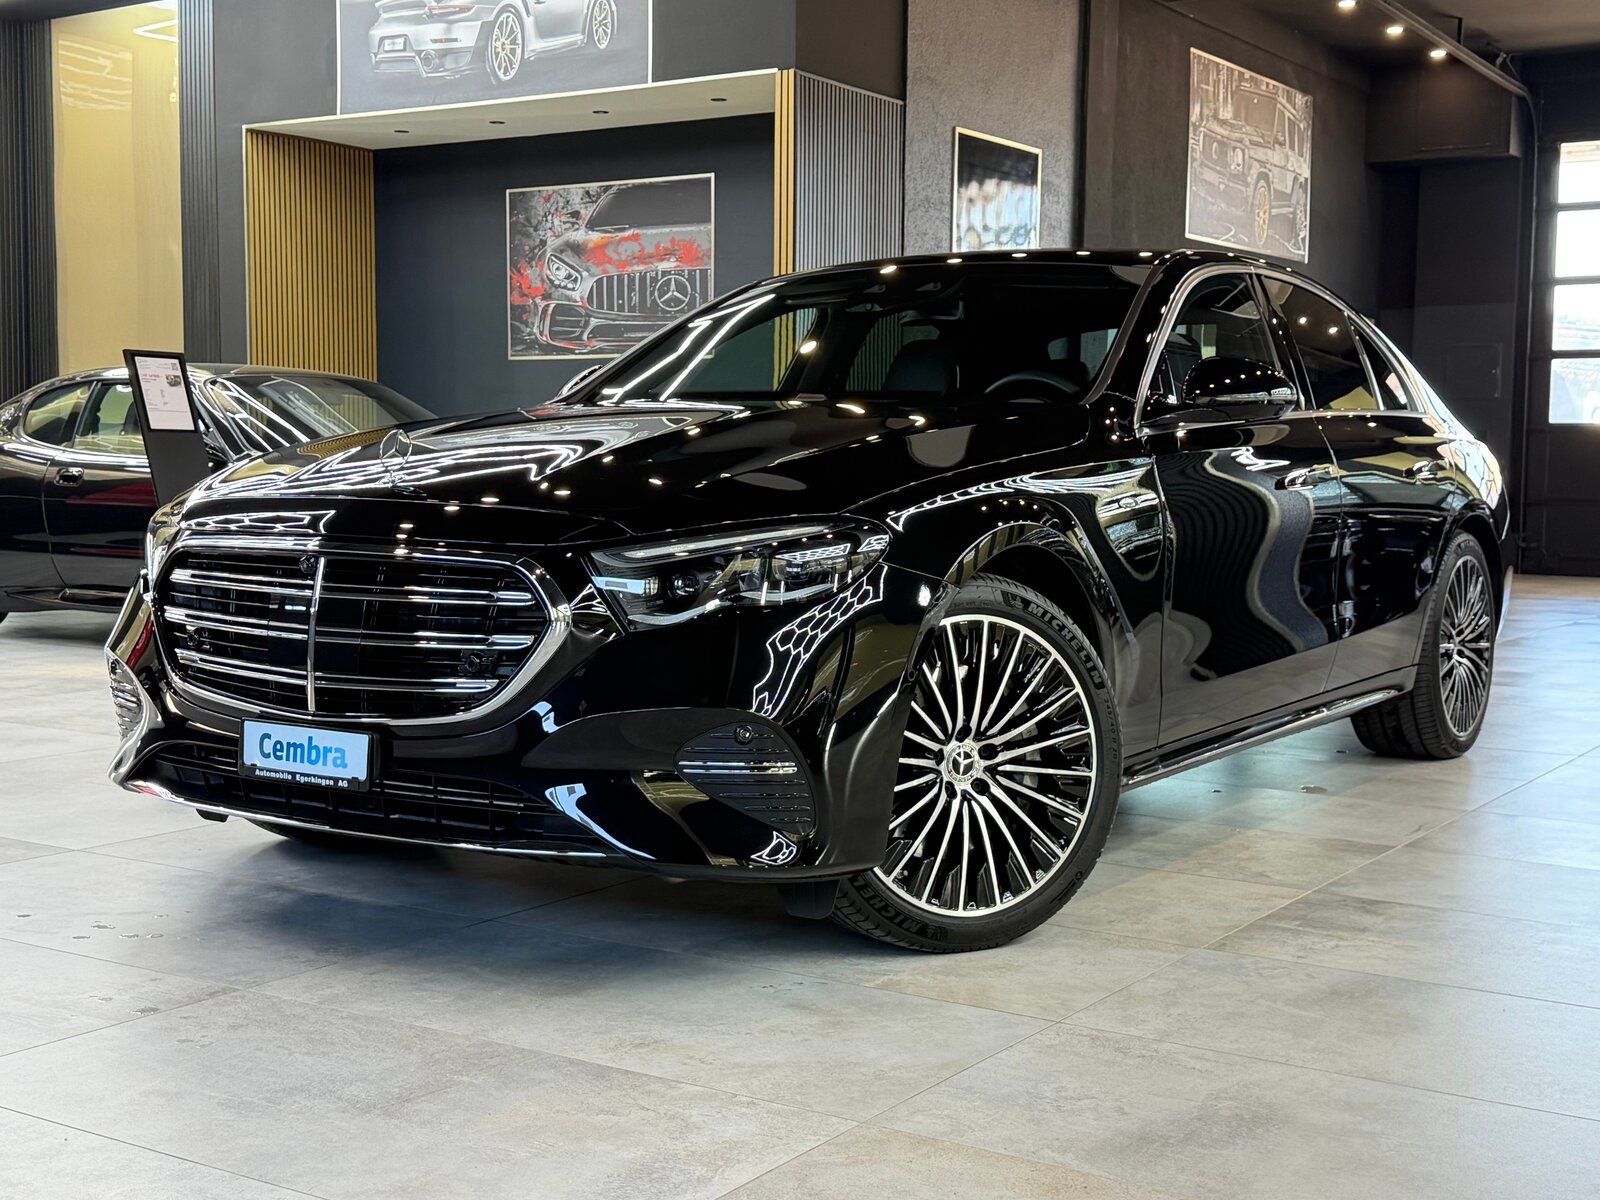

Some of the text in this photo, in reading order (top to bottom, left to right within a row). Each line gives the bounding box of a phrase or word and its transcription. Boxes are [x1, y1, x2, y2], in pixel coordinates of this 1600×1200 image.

[1027, 603, 1102, 684] MICHELIN
[259, 733, 348, 769] Cembra
[255, 768, 348, 787] Automobile Egerkingen AG
[853, 875, 922, 934] MICHEL
